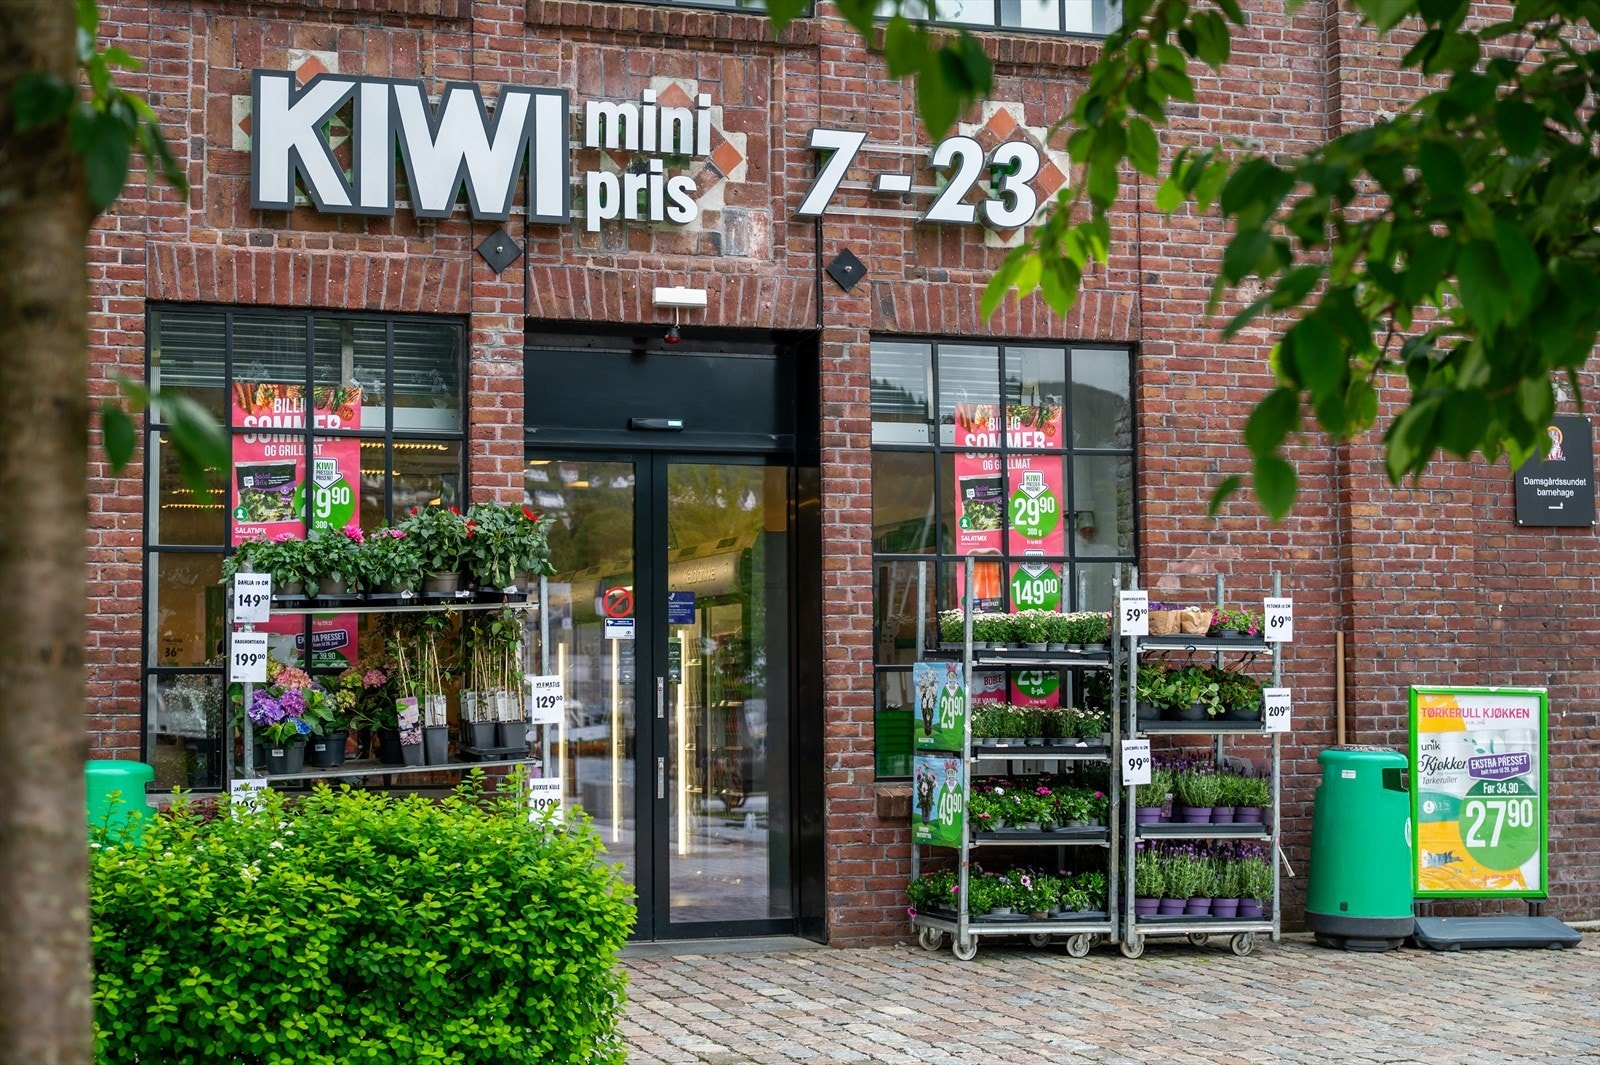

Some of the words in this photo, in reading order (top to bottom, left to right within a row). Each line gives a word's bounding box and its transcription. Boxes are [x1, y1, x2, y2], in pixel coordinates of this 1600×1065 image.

[584, 89, 712, 156] mini
[252, 70, 569, 222] KIWI
[585, 159, 699, 232] pris
[264, 445, 277, 457] OG
[279, 444, 323, 457] GRILLAT
[316, 462, 334, 470] KIWI
[982, 460, 992, 471] OG
[1026, 474, 1041, 482] KIWI
[1523, 477, 1586, 487] Damsgårdssundet
[1537, 488, 1574, 498] barnehage
[320, 631, 345, 642] PRESSET
[1421, 707, 1481, 719] TØRKERULL
[1483, 707, 1530, 719] KJØKKEN
[1421, 739, 1441, 751] unik
[1471, 757, 1497, 770] EKSTRA
[1497, 754, 1528, 767] PRESSET
[1483, 782, 1496, 794] Før
[1496, 782, 1519, 795] 34,90
